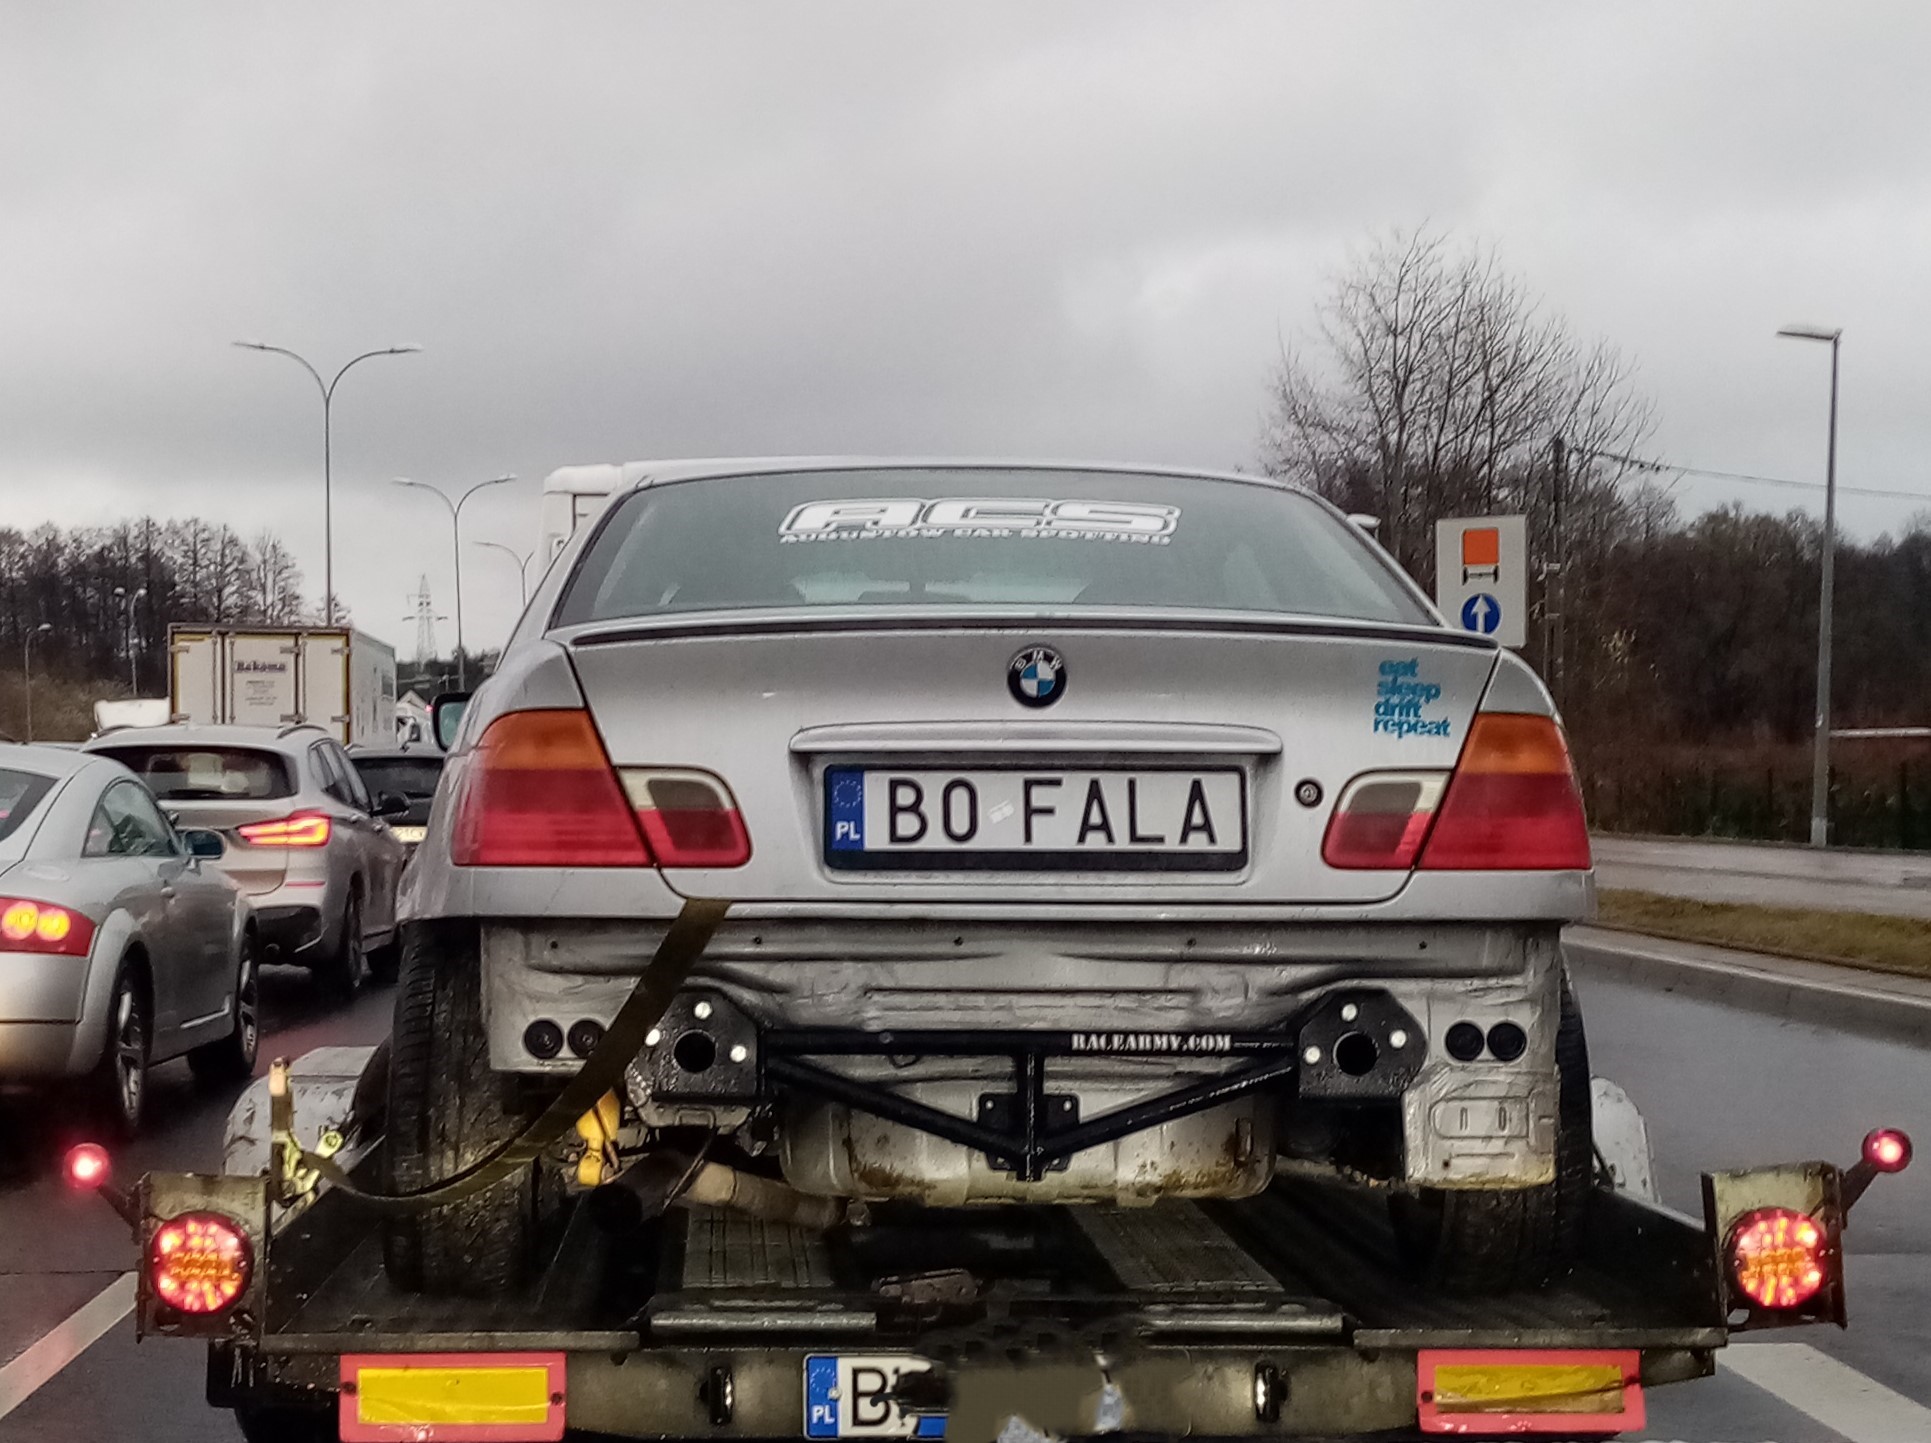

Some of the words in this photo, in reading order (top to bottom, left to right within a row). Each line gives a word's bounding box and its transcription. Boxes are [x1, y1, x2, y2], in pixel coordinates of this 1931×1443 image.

[778, 498, 1182, 535] ACS
[1014, 649, 1063, 671] BMW
[1374, 697, 1422, 718] drift
[1373, 717, 1450, 739] repeat
[1022, 777, 1218, 845] FALA
[835, 821, 861, 841] PL
[1071, 1033, 1232, 1051] RACEARMY.COM
[811, 1405, 836, 1425] PL
